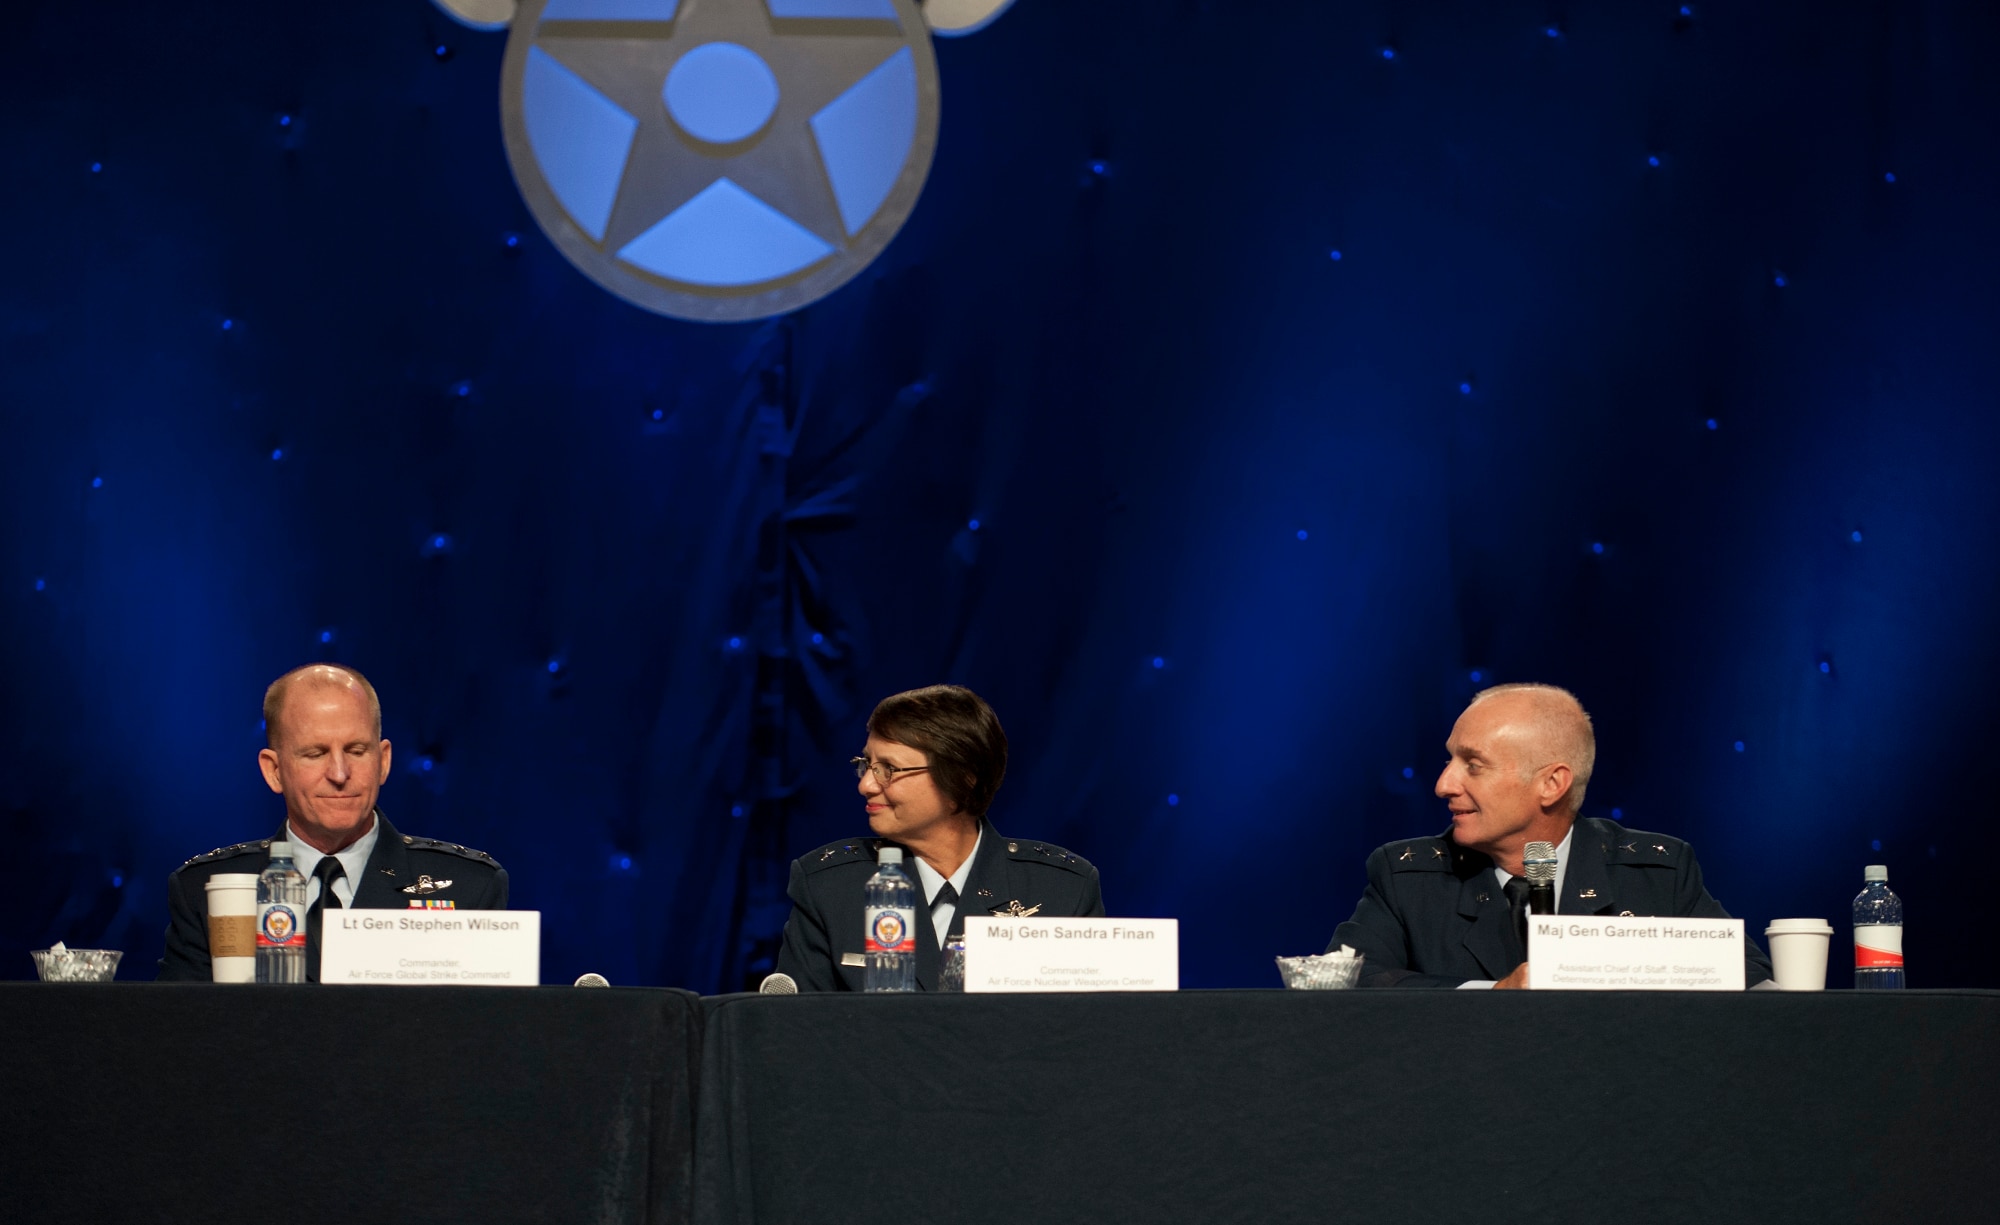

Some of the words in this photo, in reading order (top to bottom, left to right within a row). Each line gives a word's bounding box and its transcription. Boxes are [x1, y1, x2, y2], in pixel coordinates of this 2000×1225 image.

[343, 917, 357, 930] Lt
[363, 917, 393, 930] Gen
[400, 918, 462, 932] Stephen
[467, 918, 519, 930] Wilson
[988, 926, 1013, 940] Maj
[1019, 926, 1048, 938] Gen
[1054, 927, 1107, 939] Sandra
[1113, 927, 1154, 939] Finan
[1538, 925, 1563, 938] Maj
[1570, 925, 1599, 936] Gen
[1605, 926, 1658, 937] Garrett
[1664, 927, 1735, 939] Harencak
[348, 971, 361, 979] Air
[365, 971, 392, 979] Force
[396, 971, 427, 979] Global
[431, 971, 457, 979] Strike
[461, 971, 511, 979] Command
[1558, 964, 1601, 973] Assistant
[1604, 964, 1628, 973] Chief
[1632, 964, 1641, 973] of
[1673, 965, 1715, 975] Strategic
[1075, 978, 1118, 987] Weapons
[1553, 974, 1605, 983] Deterrence
[1609, 975, 1626, 983] and
[1630, 976, 1667, 984] Nuclear
[1671, 976, 1721, 986] Integration
